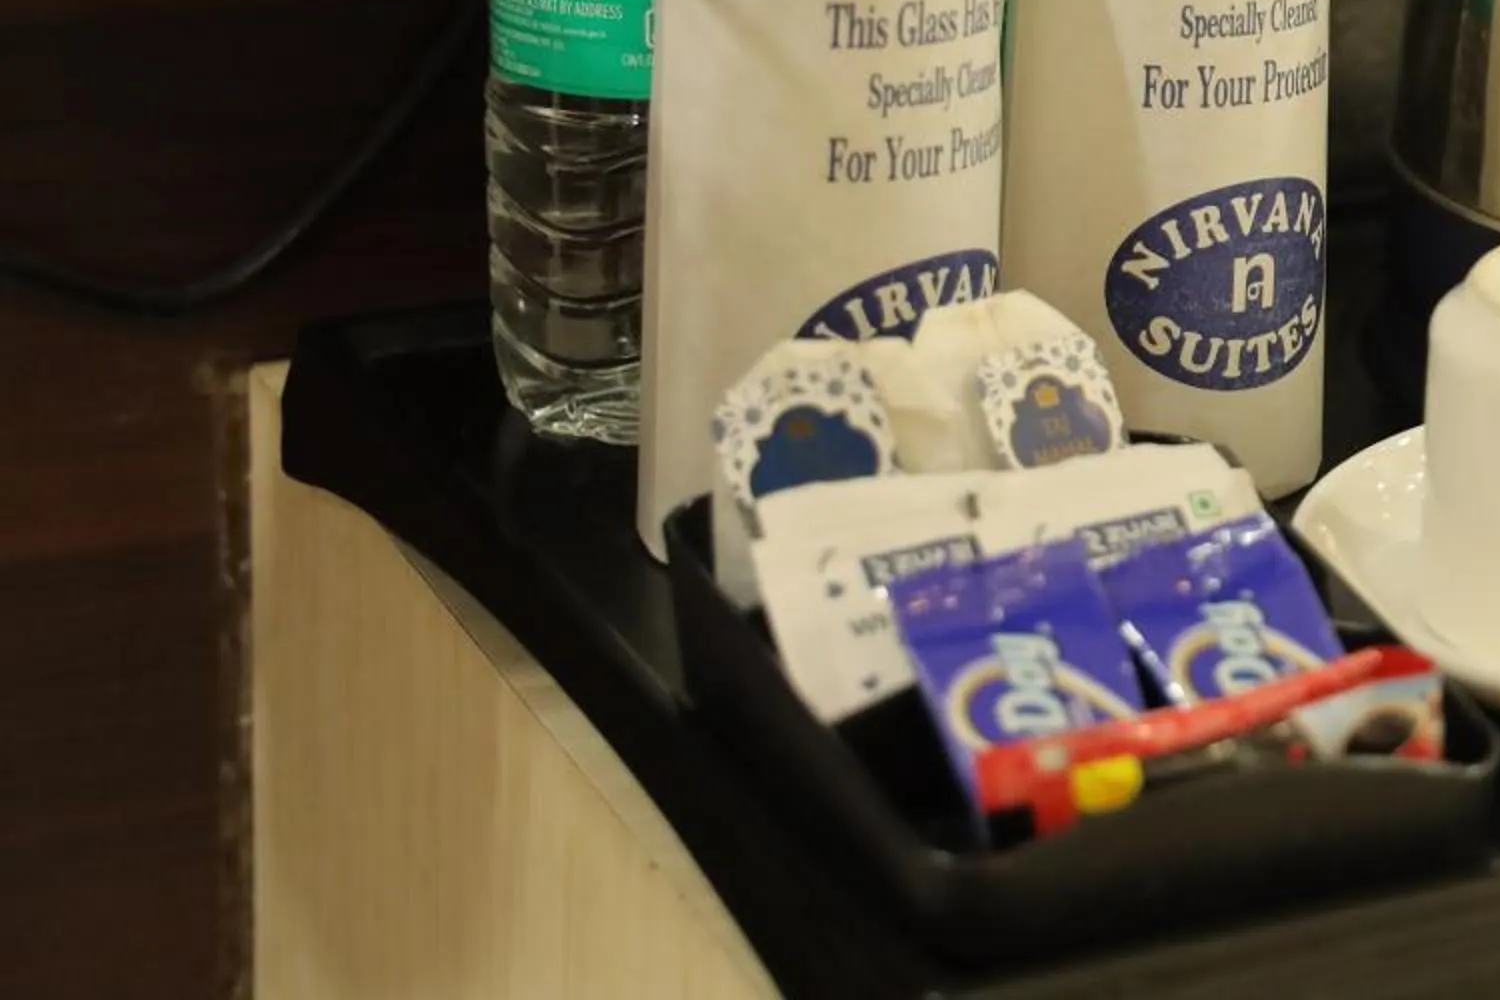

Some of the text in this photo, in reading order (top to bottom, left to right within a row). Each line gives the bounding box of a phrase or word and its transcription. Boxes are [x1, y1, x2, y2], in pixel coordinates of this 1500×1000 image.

[825, 0, 889, 50] This
[896, 0, 958, 48] Glass
[1180, 1, 1266, 49] Specially
[867, 66, 955, 118] Specially
[1141, 64, 1190, 109] For
[1197, 65, 1257, 109] Your
[827, 136, 878, 183] For
[885, 135, 945, 182] Your
[1121, 190, 1325, 290] NIRVANA
[814, 263, 997, 340] IRVAN
[1138, 294, 1317, 379] SUITES
